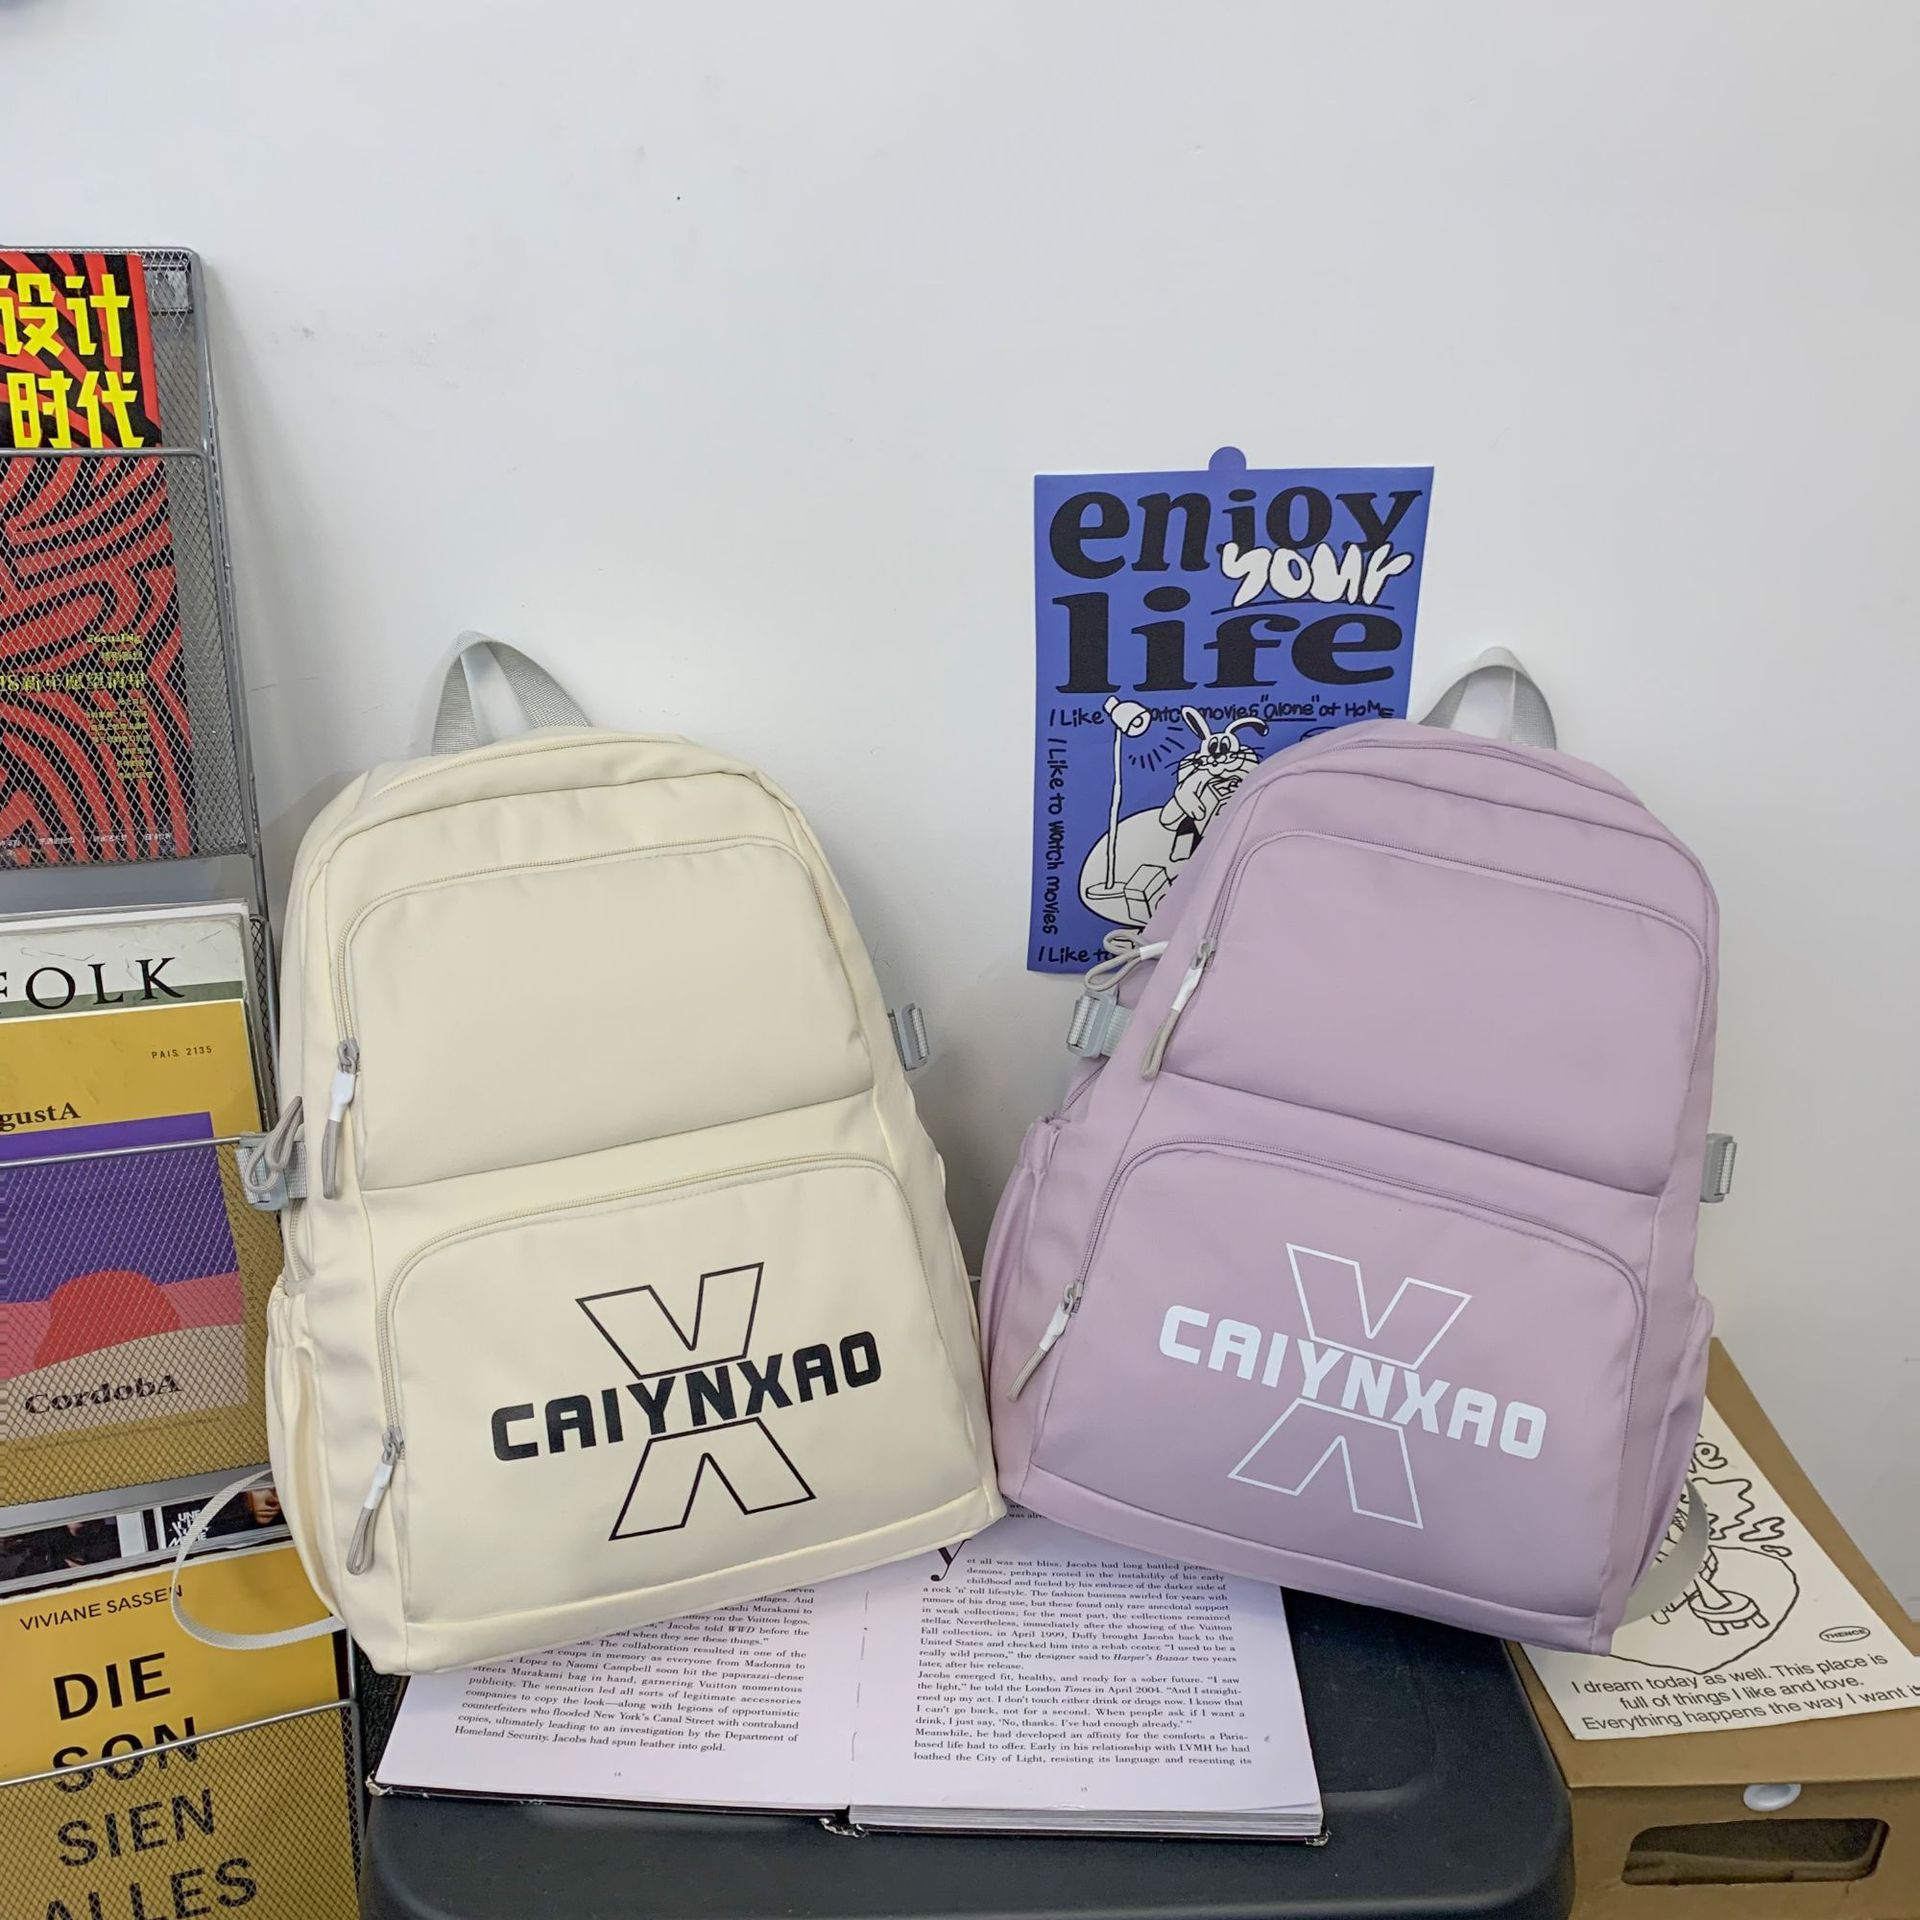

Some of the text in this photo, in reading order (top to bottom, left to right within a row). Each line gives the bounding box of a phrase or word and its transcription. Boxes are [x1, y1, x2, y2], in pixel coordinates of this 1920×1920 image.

[0, 273, 130, 357] 设计
[6, 370, 144, 449] 时代
[1049, 486, 1423, 579] enjoy
[1219, 541, 1413, 607] your
[1052, 586, 1403, 694] life
[1060, 708, 1105, 728] Like
[0, 957, 185, 1012] OLK
[1049, 946, 1090, 964] Like
[19, 1603, 102, 1630] VIVIANE
[53, 1651, 171, 1721] DIE
[1584, 1680, 1643, 1694] dream
[1645, 1674, 1698, 1690] today
[1703, 1673, 1727, 1686] as
[1728, 1667, 1772, 1682] well.
[1770, 1662, 1815, 1678] This
[1816, 1655, 1868, 1675] place
[1868, 1653, 1888, 1665] is
[1620, 1696, 1650, 1710] full
[1652, 1694, 1671, 1708] of
[1673, 1690, 1731, 1706] things
[1741, 1685, 1776, 1699] like
[1779, 1680, 1816, 1695] and
[1816, 1676, 1865, 1691] love.
[1581, 1713, 1682, 1731] Everything
[1682, 1706, 1767, 1726] happens
[1768, 1701, 1802, 1716] the
[1803, 1696, 1844, 1710] way
[1858, 1686, 1909, 1701] want
[52, 1716, 198, 1793] SON
[56, 1787, 215, 1867] SIEN
